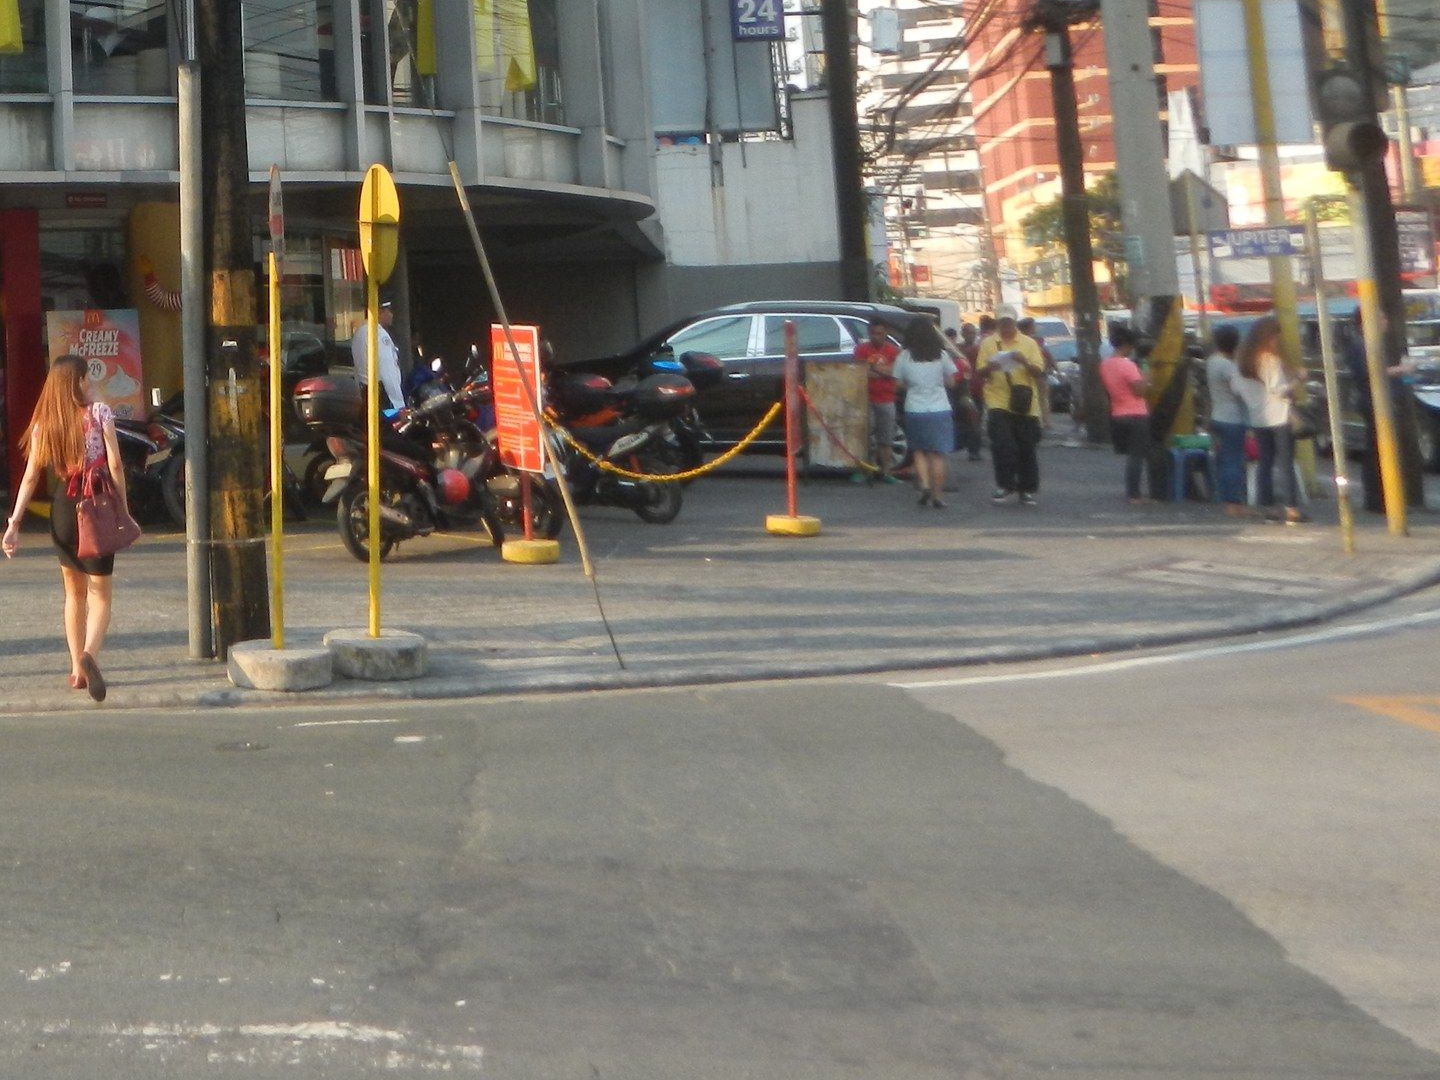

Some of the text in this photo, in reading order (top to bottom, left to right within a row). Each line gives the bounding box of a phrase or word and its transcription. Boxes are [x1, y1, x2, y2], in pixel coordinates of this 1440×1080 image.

[738, 20, 779, 37] hours
[1226, 230, 1291, 246] JUPITER
[80, 329, 119, 342] CREAMY
[69, 342, 119, 356] McFREEZE
[91, 363, 102, 376] 29
